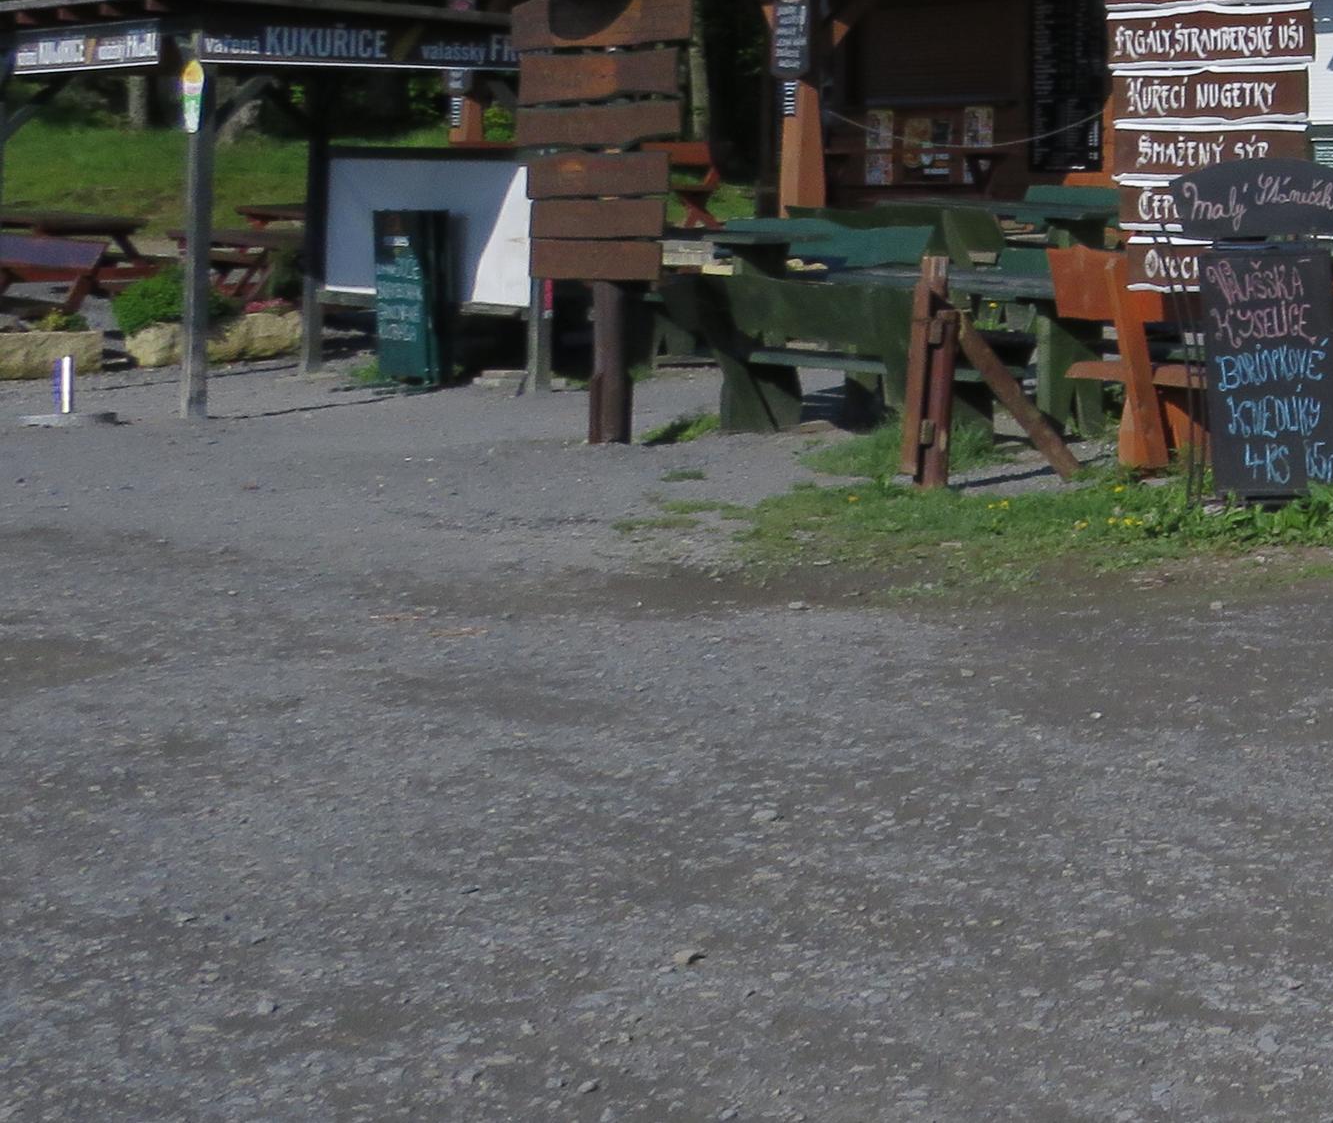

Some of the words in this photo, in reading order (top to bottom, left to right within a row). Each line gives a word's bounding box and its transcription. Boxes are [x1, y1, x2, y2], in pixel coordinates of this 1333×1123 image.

[204, 34, 260, 54] vařená
[265, 24, 388, 59] KUKUŘICE
[1279, 19, 1304, 50] UŠI
[1127, 77, 1188, 116] KUŘECÍ
[1196, 82, 1276, 113] NUGETKY
[1182, 181, 1249, 231] Malý
